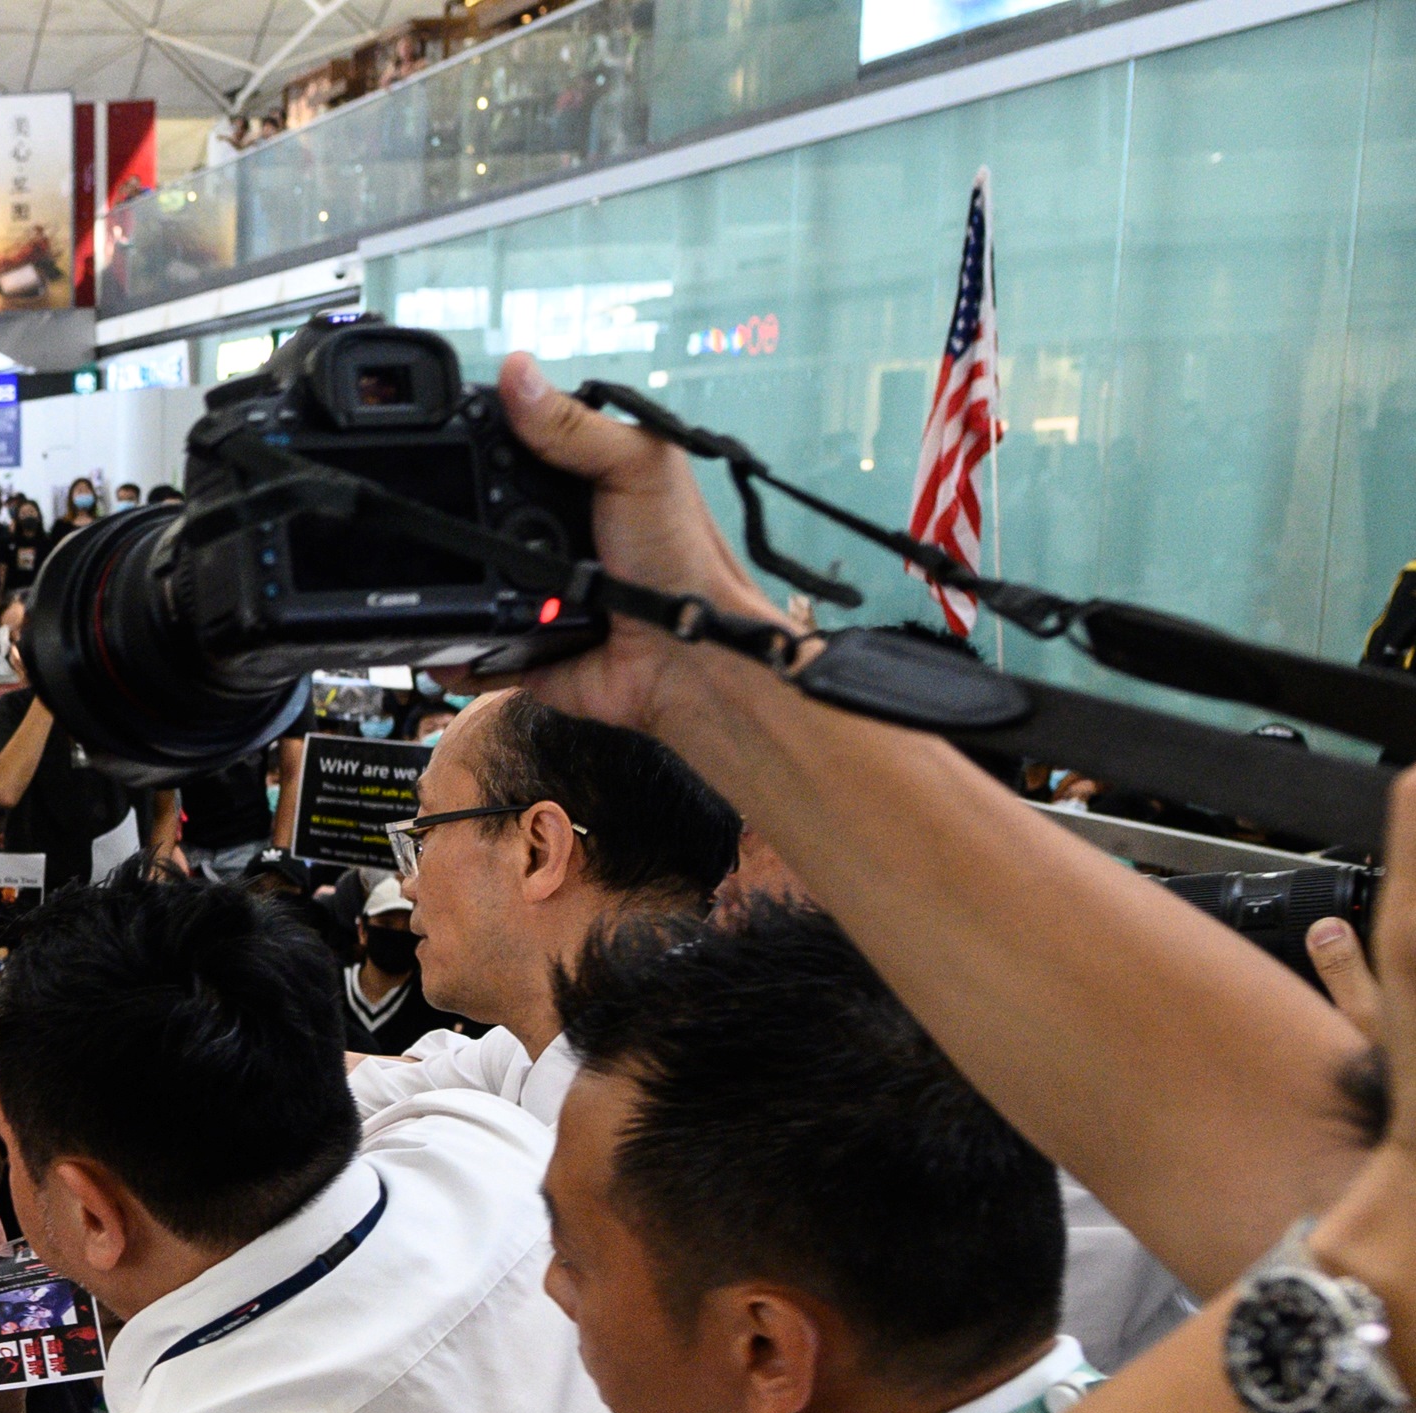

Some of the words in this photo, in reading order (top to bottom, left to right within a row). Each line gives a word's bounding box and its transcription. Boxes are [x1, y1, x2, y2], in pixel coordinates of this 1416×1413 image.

[319, 757, 360, 776] WHY
[362, 764, 390, 780] are
[393, 767, 418, 781] we
